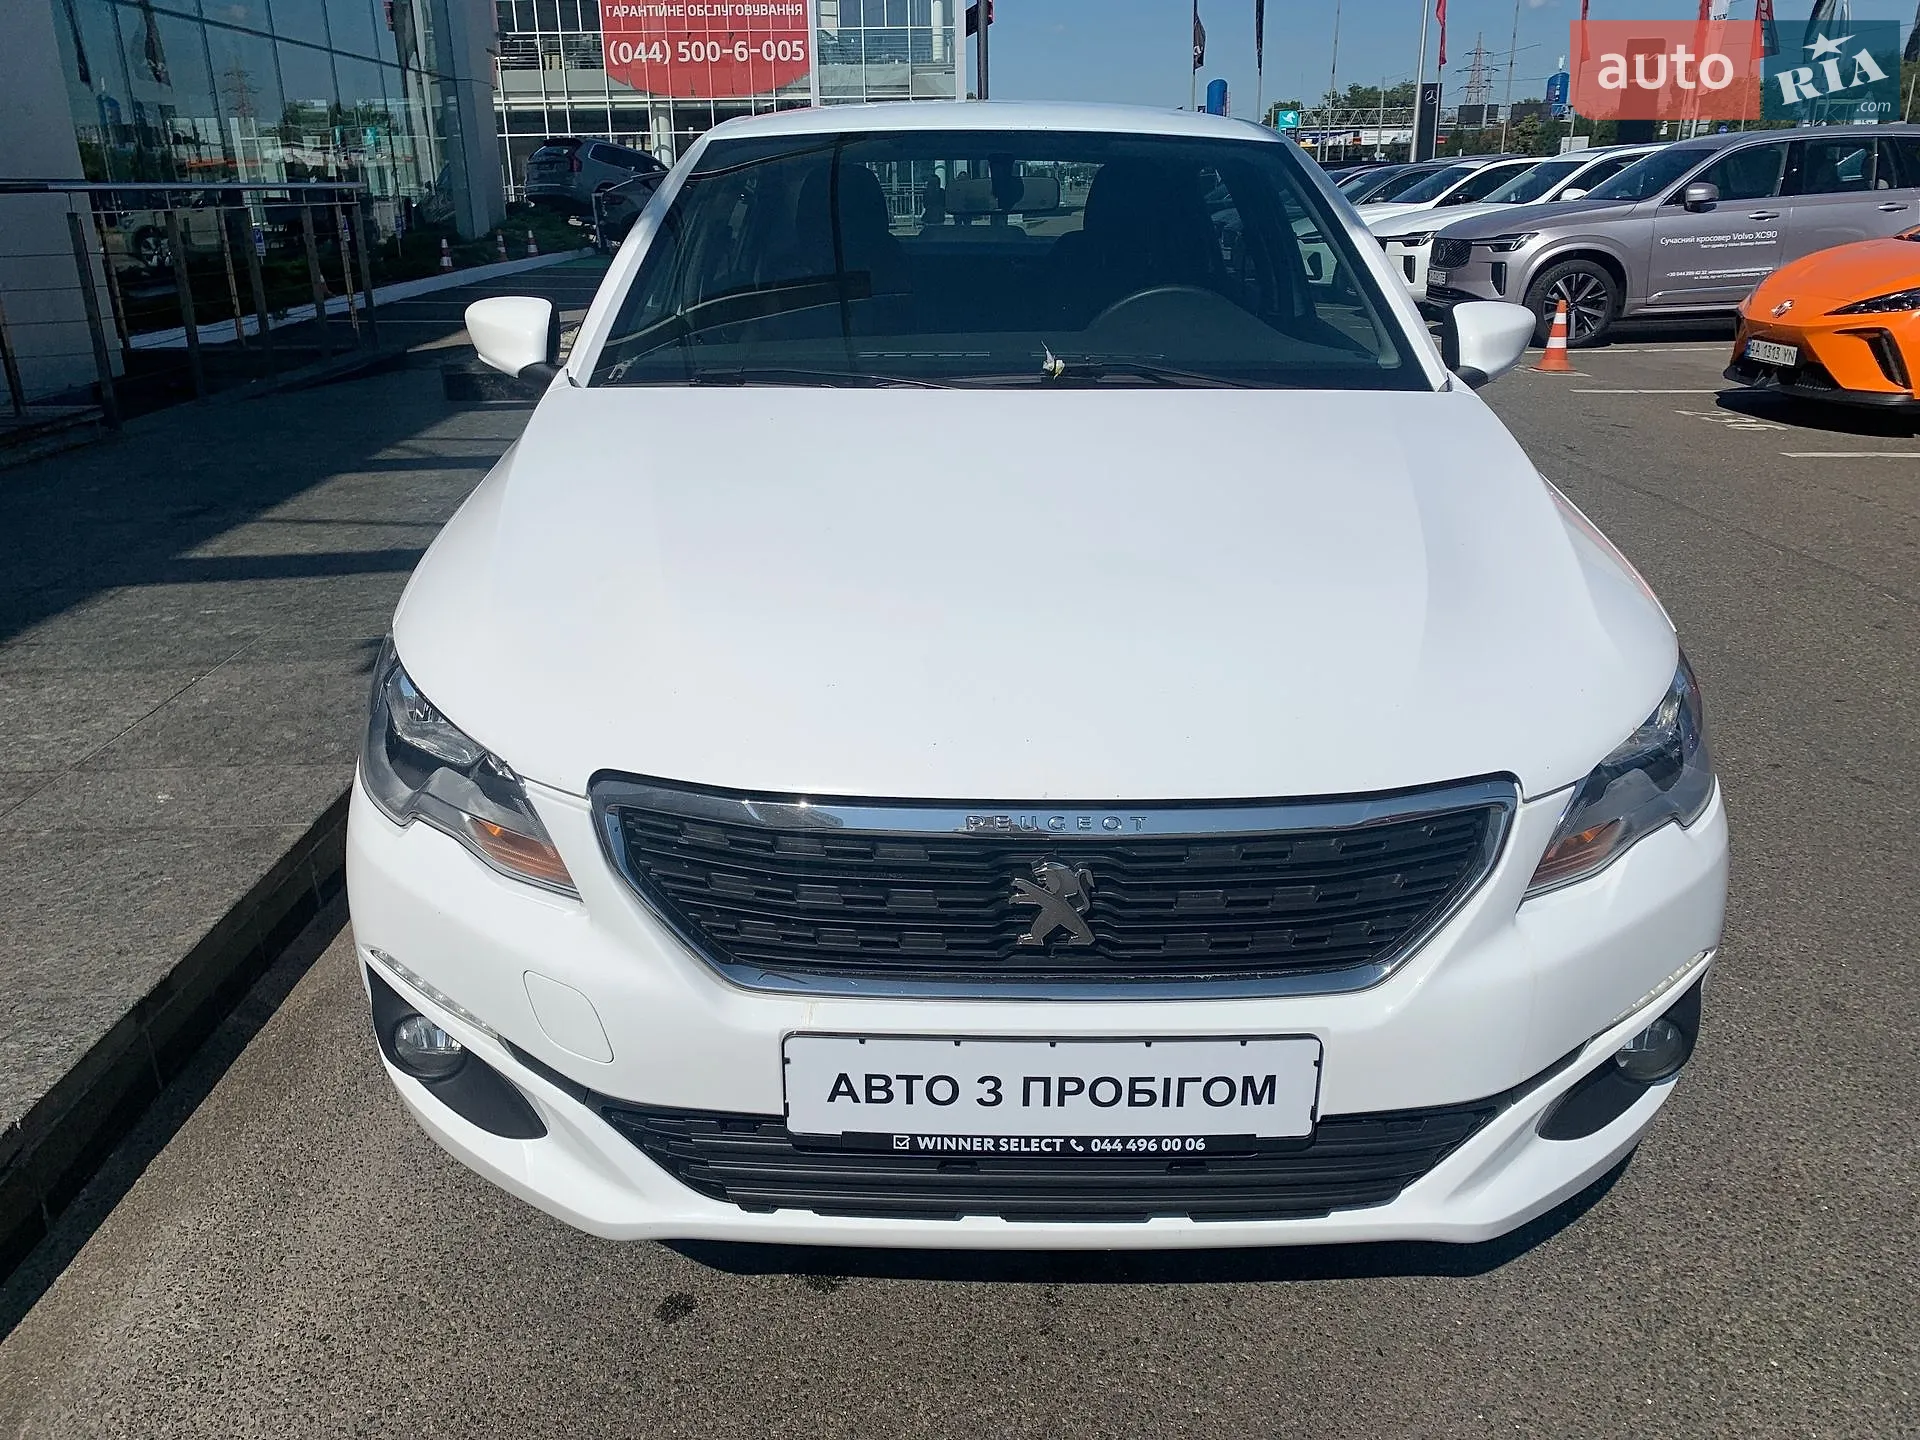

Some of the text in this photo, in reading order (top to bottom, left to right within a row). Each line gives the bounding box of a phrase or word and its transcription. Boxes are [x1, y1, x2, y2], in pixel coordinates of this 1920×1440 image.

[605, 3, 803, 17] ГАРАНТІЙНЕ ОБСЛУГОВУВАННЯ
[609, 40, 805, 65] (044) 500-6-005
[1660, 236, 1695, 247] Сучасний
[1696, 235, 1731, 244] кросовер
[1732, 232, 1754, 241] Volvo
[1754, 230, 1778, 239] XC90
[1763, 344, 1781, 360] 1313
[965, 815, 1148, 832] PEUGEOT
[826, 1072, 1278, 1108] АВТО З ПРОБІГОМ
[917, 1136, 1206, 1152] WINNER SELECT 044 496 00 06
